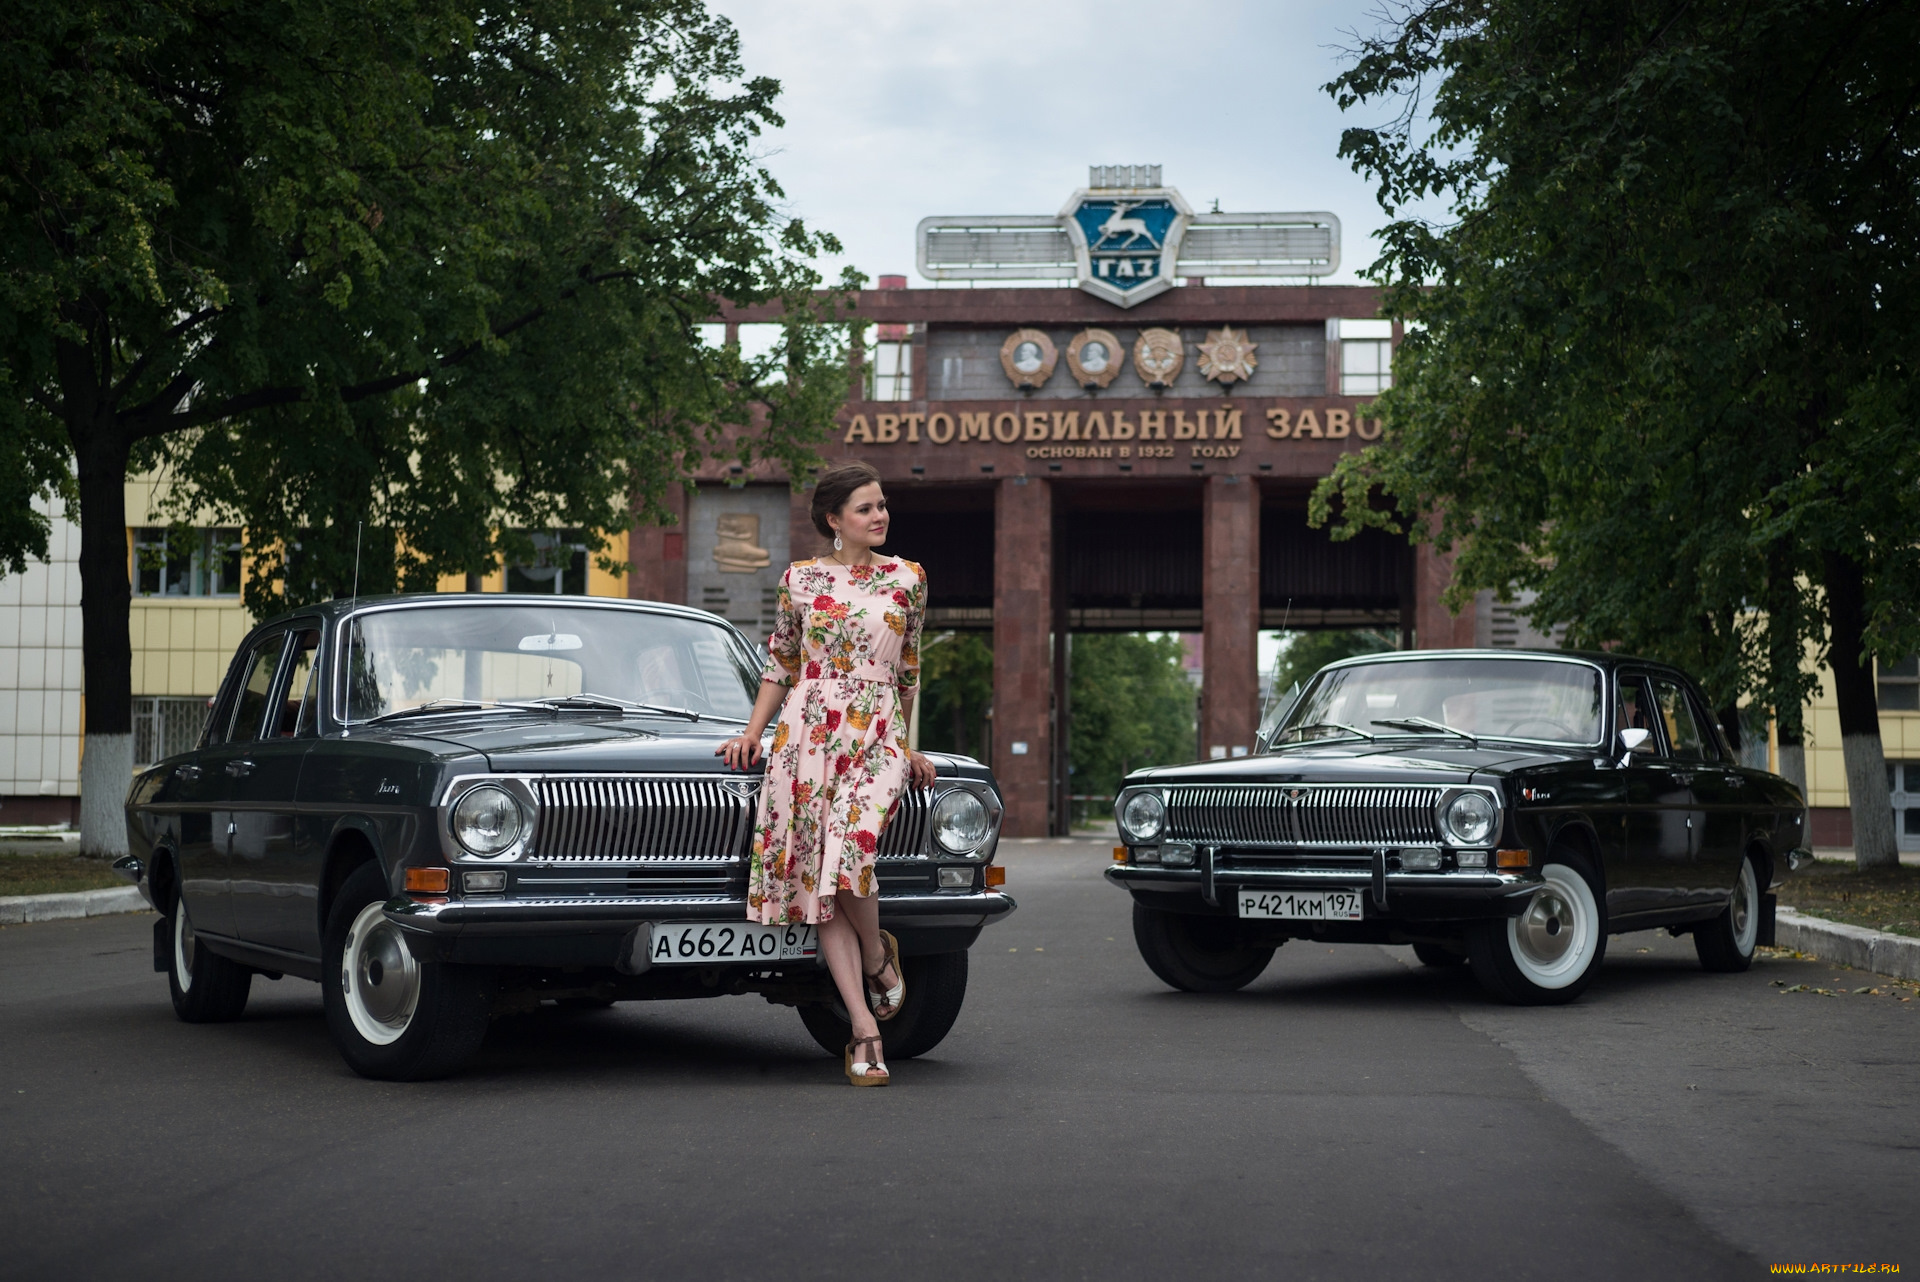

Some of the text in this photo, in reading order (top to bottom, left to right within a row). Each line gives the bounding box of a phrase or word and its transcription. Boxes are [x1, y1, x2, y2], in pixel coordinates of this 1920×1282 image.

[1098, 259, 1153, 277] ГАЗ
[844, 404, 1243, 444] АВТОМОБИЛЬНЫЙ
[1026, 446, 1240, 459] ОСНОВАН В 1932 ГОДУ
[1326, 894, 1355, 911] 197
[785, 924, 811, 946] 67
[782, 947, 803, 956] RUS
